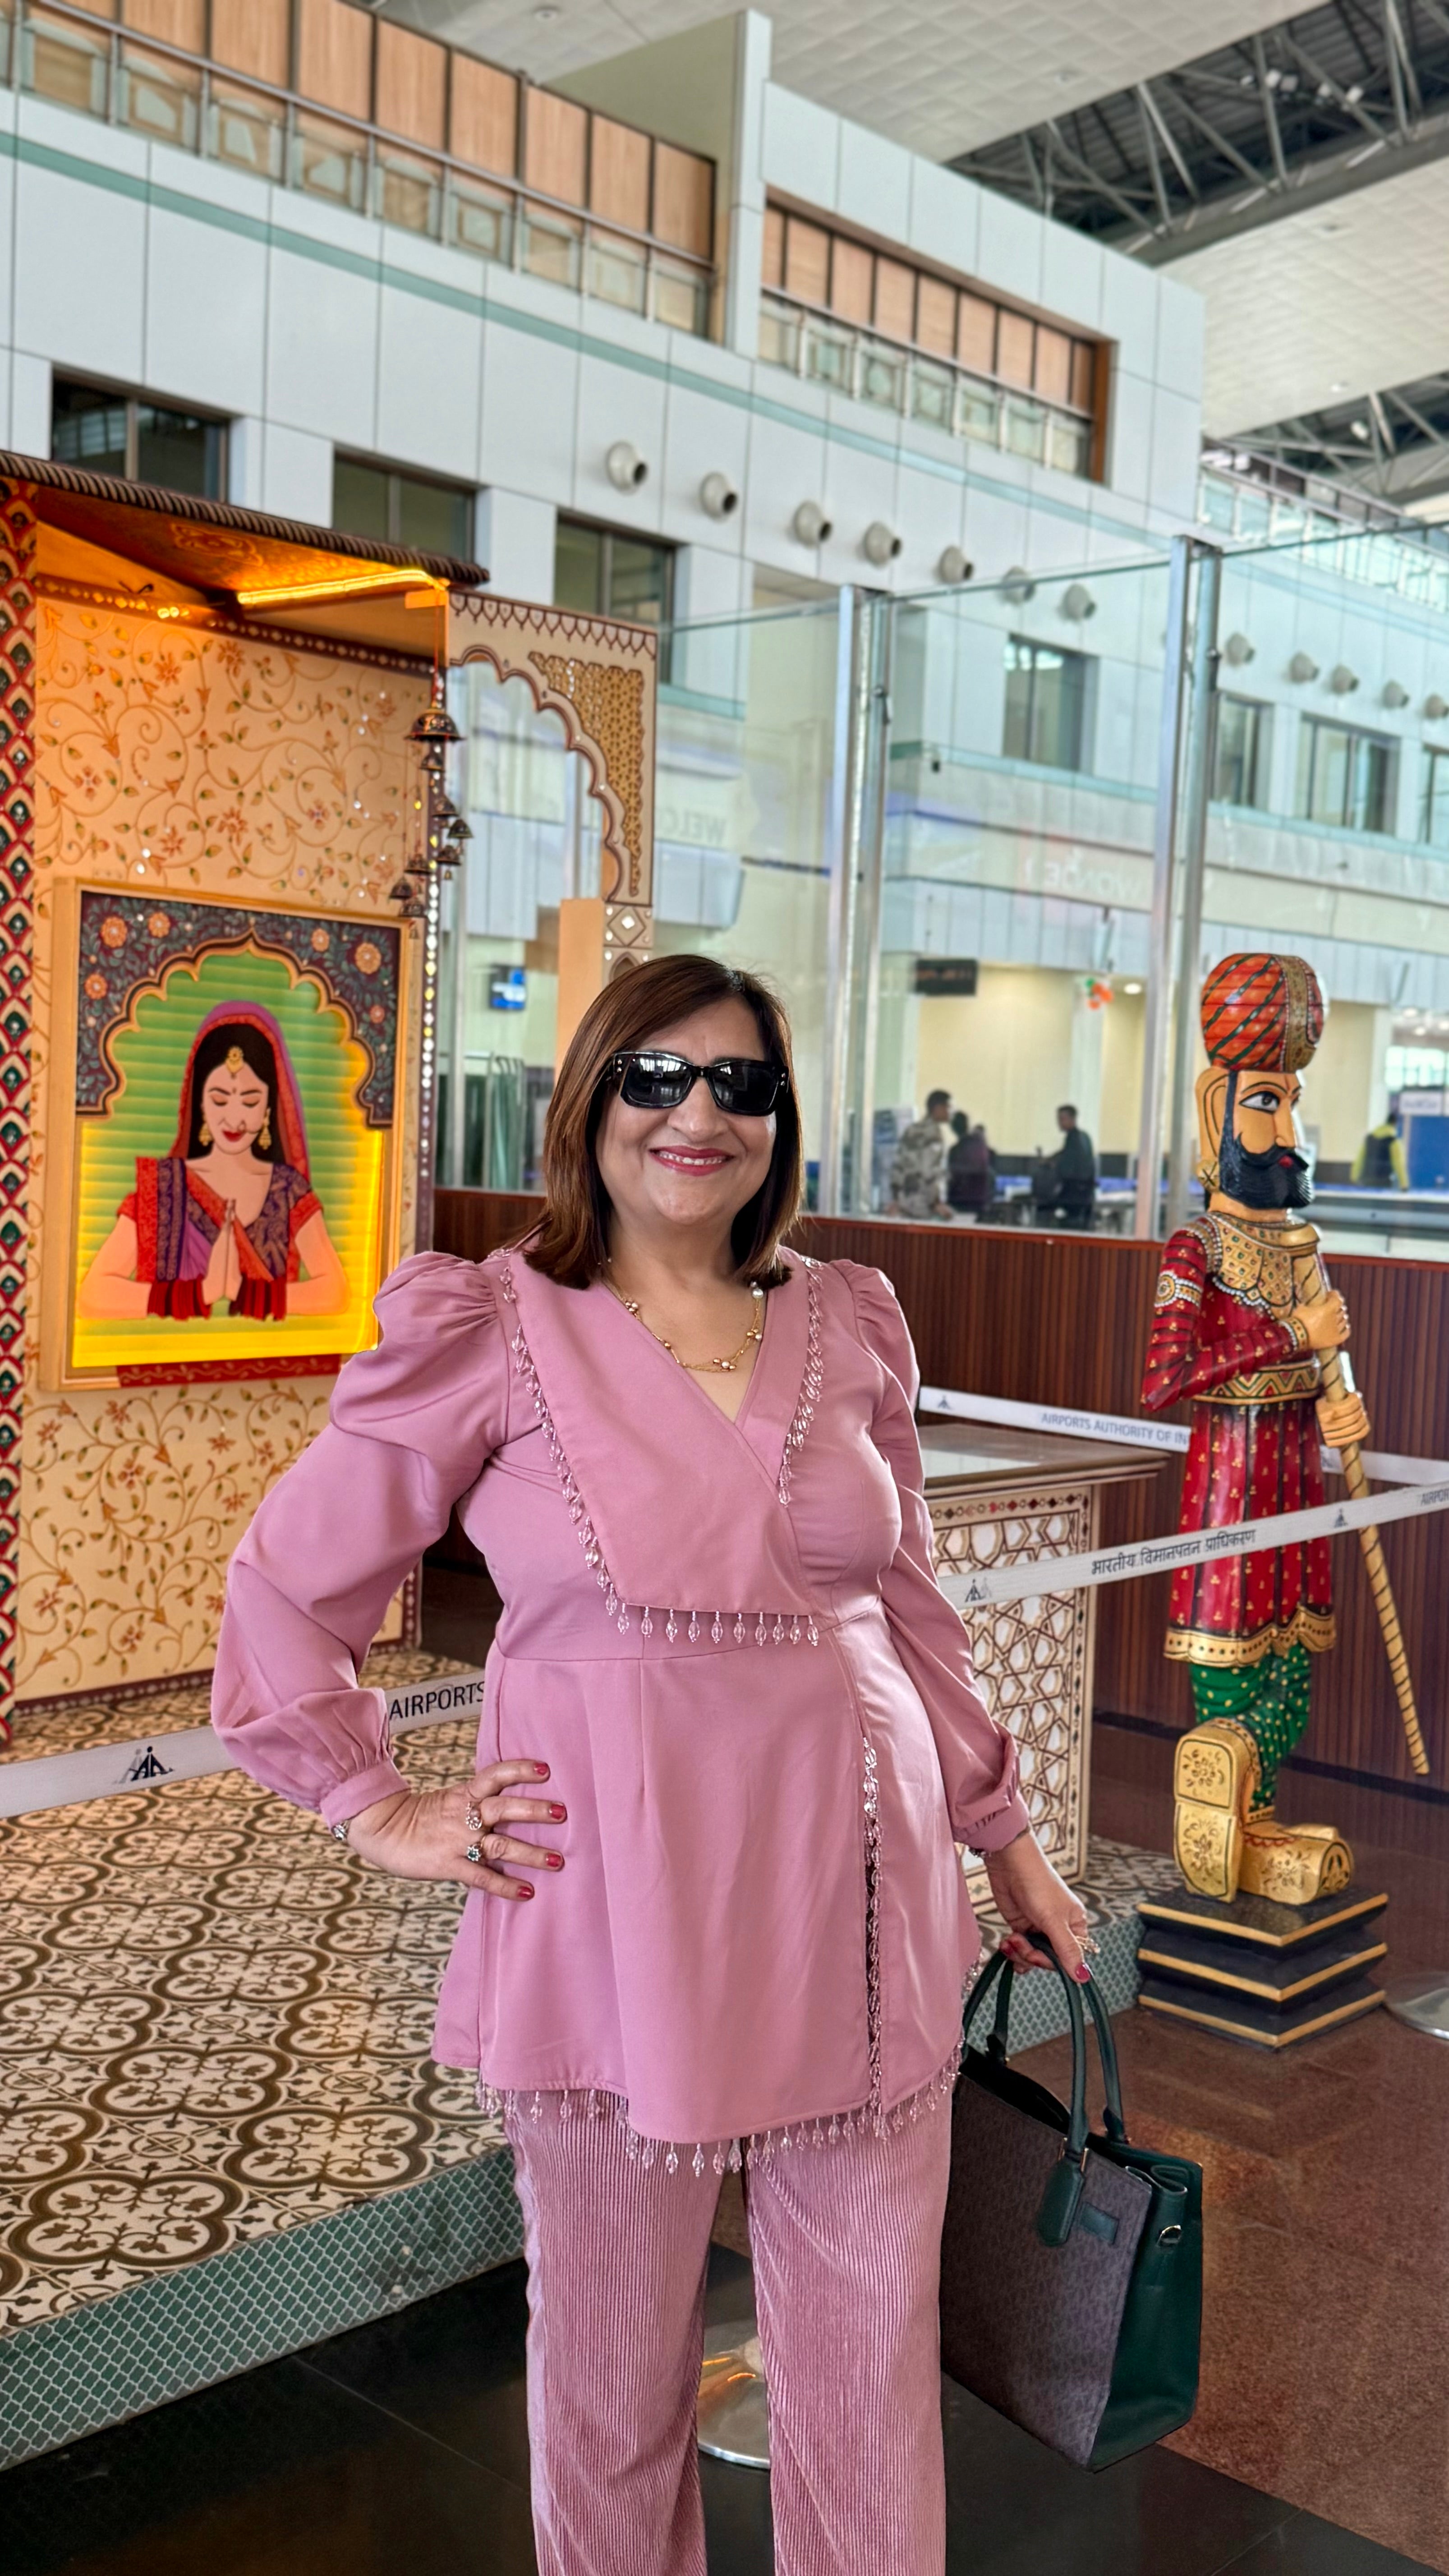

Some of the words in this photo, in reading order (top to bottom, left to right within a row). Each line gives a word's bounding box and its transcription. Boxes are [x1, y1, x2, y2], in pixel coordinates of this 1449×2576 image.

[1041, 1413, 1091, 1430] AIRPORTS
[1094, 1420, 1153, 1440] AUTHORITY
[1156, 1430, 1172, 1443] OF
[1091, 1552, 1136, 1575] भारतीय
[1141, 1546, 1201, 1566] विमानपतन
[1205, 1529, 1256, 1552] प्राधिकरण
[389, 1680, 485, 1720] AIRPORTS
